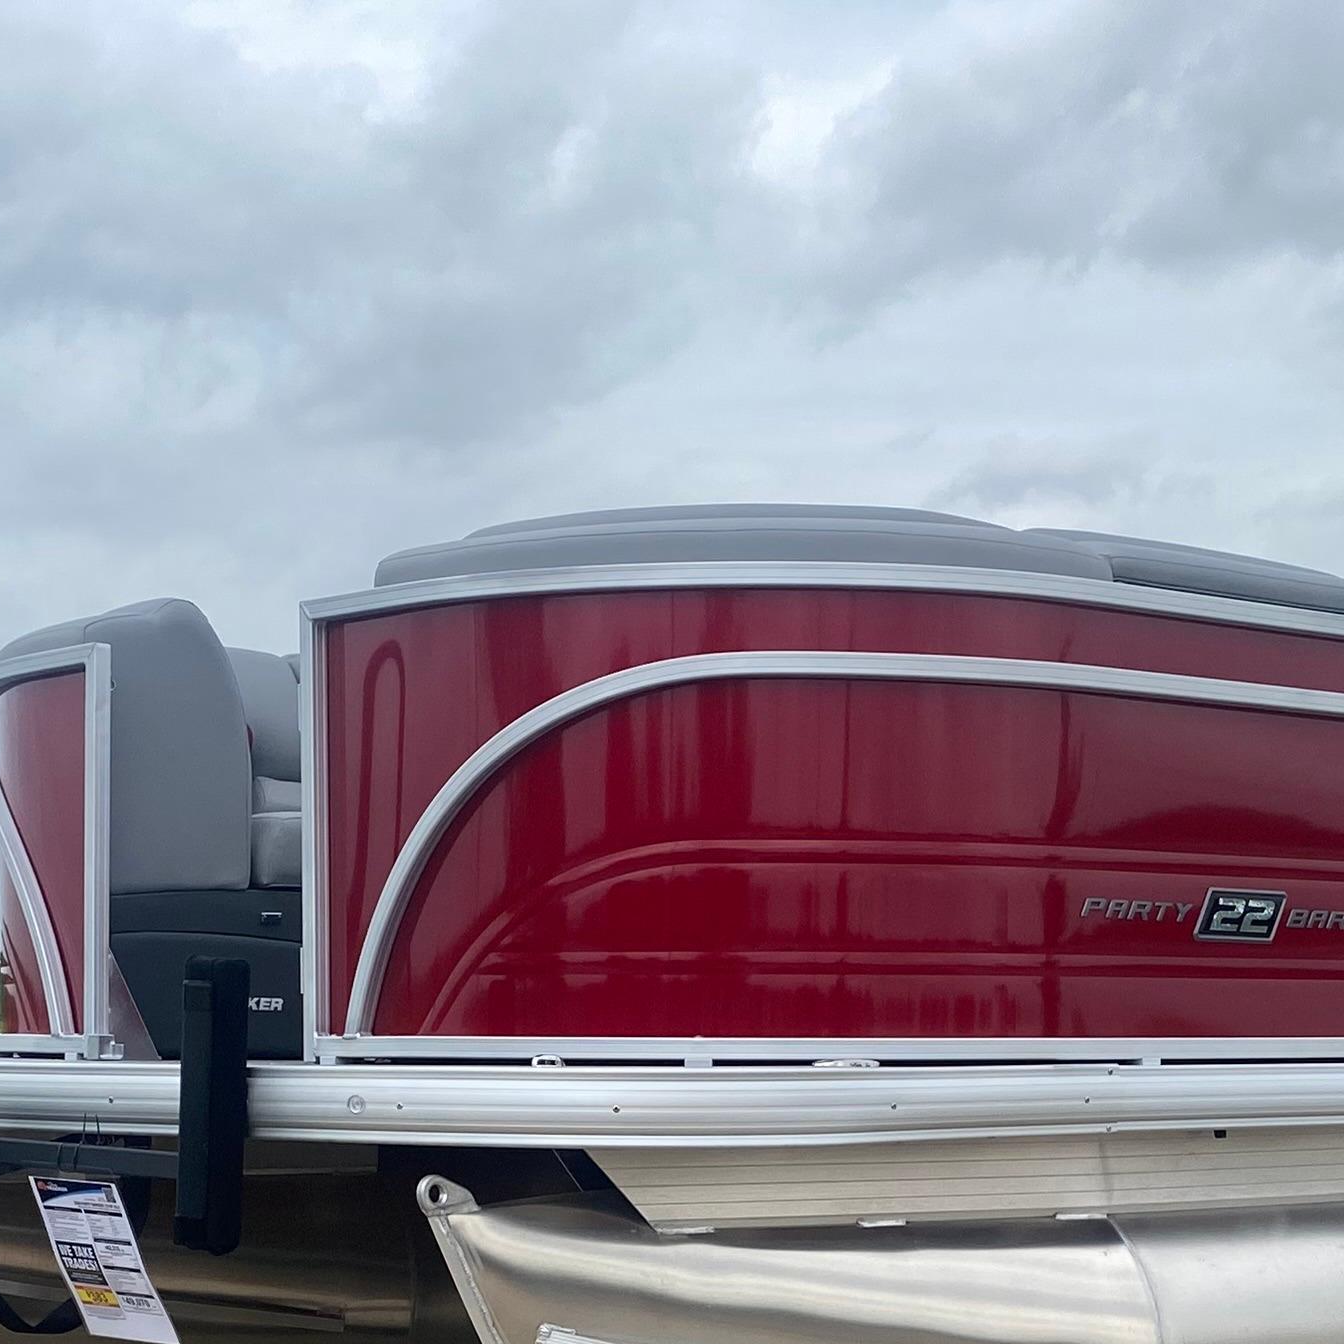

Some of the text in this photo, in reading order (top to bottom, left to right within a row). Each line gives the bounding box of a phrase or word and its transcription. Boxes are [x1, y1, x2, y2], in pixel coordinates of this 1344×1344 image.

[1080, 897, 1193, 922] PARTY
[1209, 897, 1275, 933] 22
[57, 1243, 74, 1257] WE
[74, 1245, 95, 1259] TAKE
